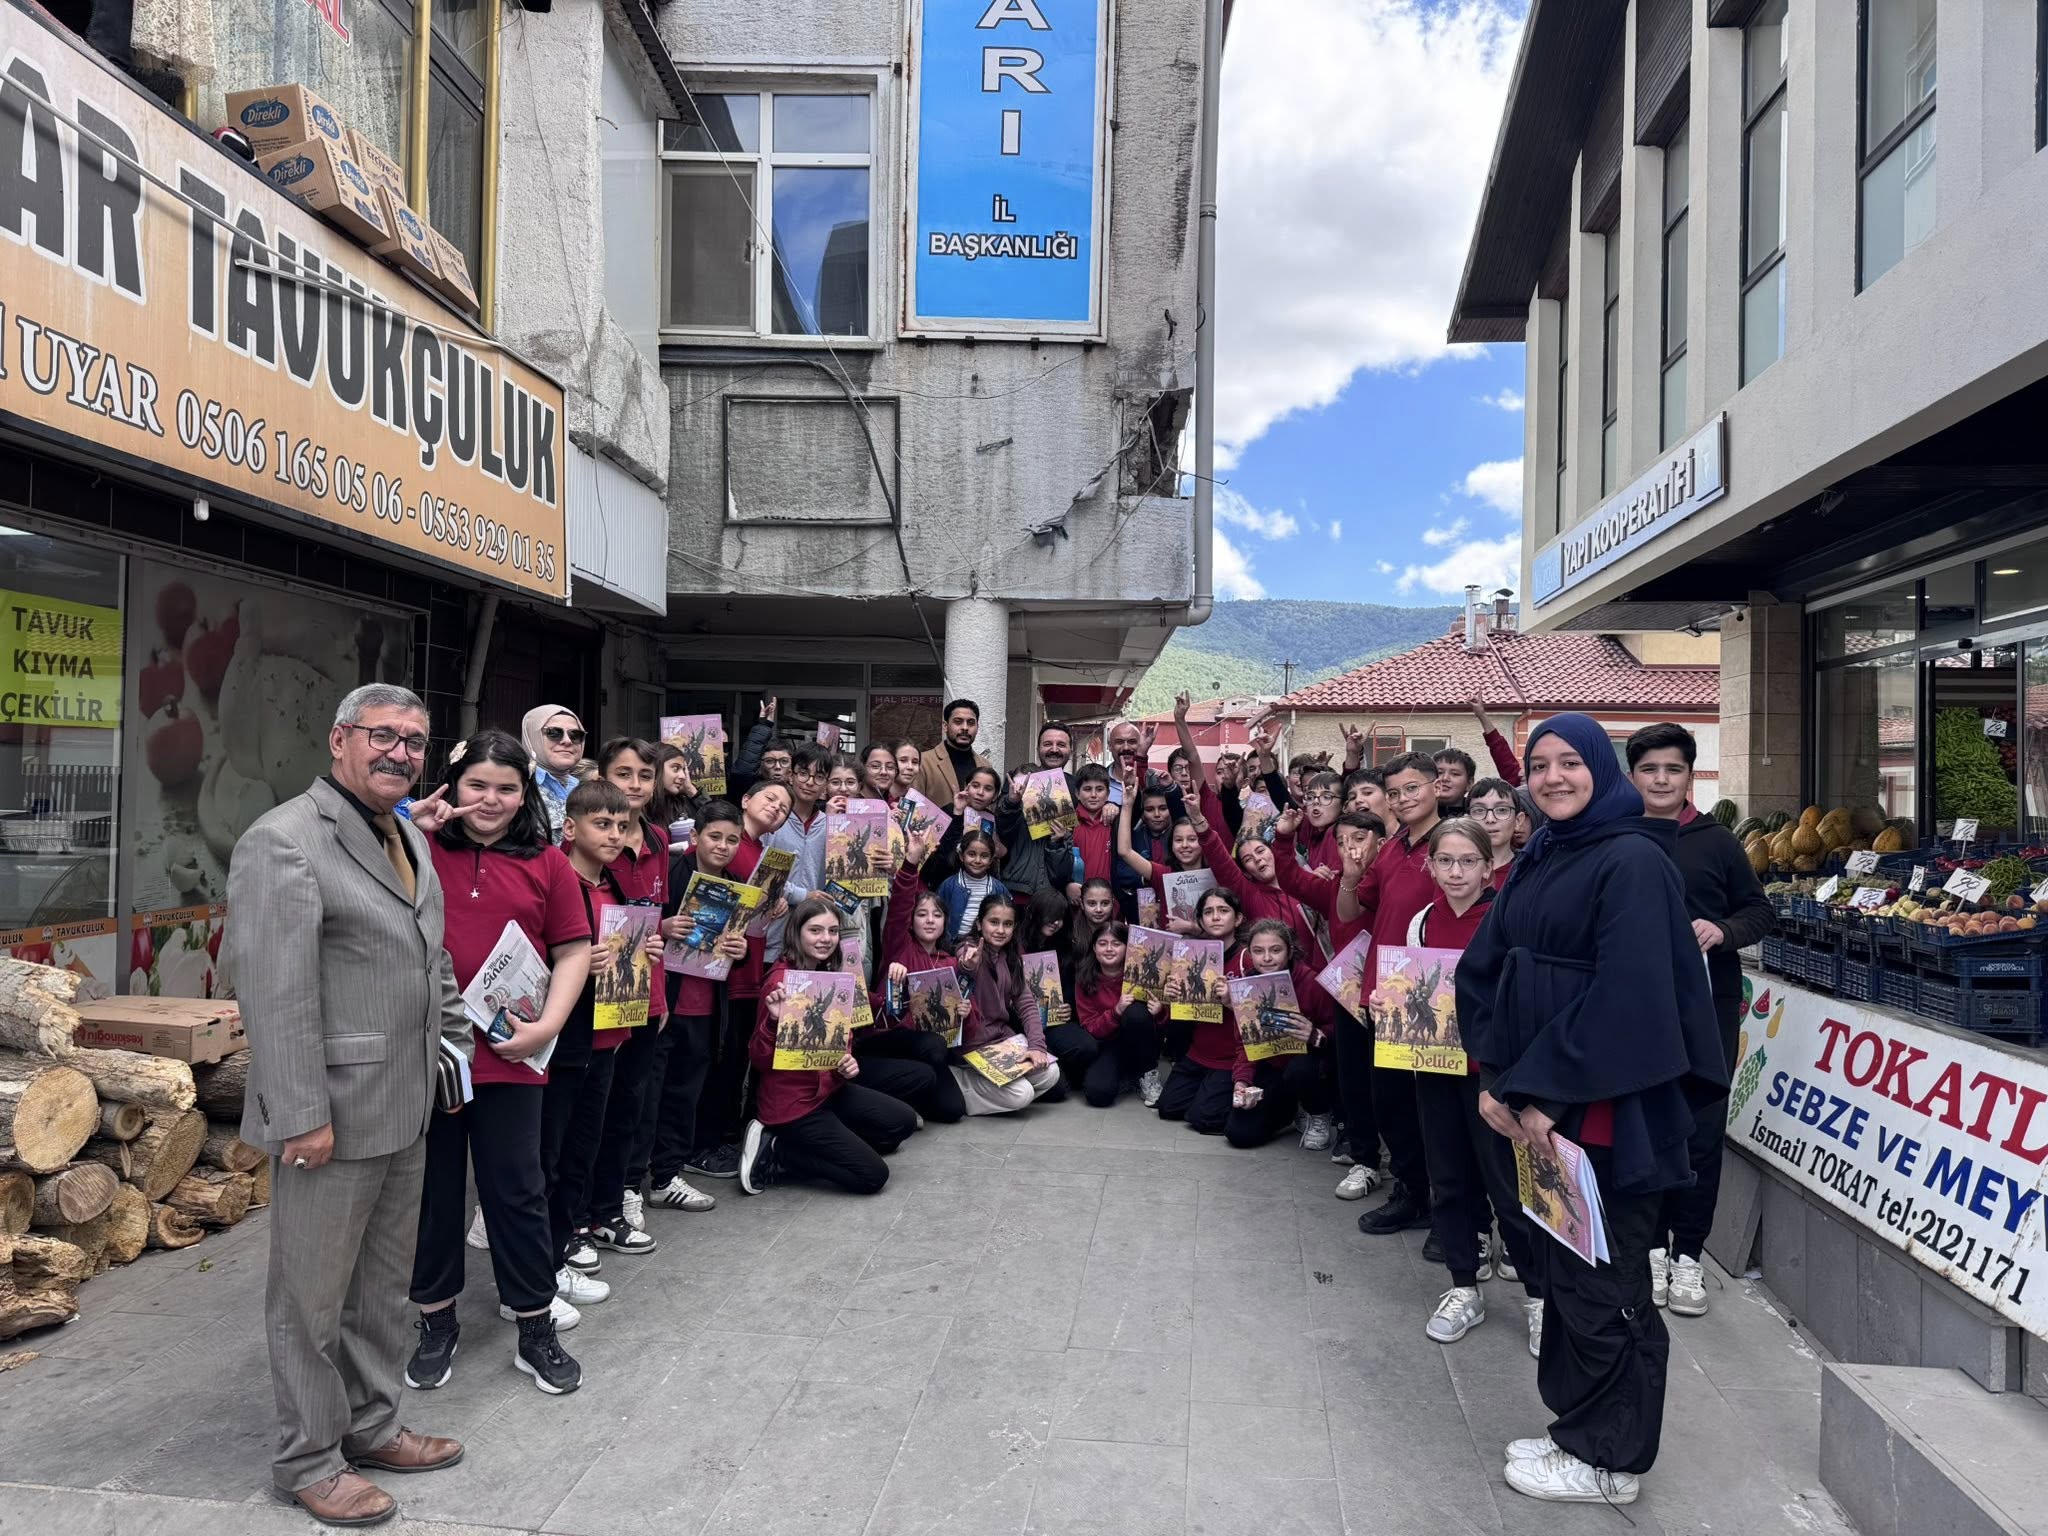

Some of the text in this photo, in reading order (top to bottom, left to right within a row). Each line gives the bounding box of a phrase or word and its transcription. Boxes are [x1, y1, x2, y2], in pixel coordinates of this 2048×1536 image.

[247, 105, 281, 122] Direkli
[273, 161, 306, 183] Direkli
[992, 194, 1016, 222] İL
[929, 231, 1078, 261] BAŞKANLIĞI
[177, 162, 557, 508] TAVUKÇULUK
[16, 315, 165, 437] UYAR
[177, 389, 266, 474] 0506
[275, 431, 328, 498] 165
[333, 455, 367, 513] 05
[372, 471, 403, 524] 06
[420, 491, 471, 550] 0553
[474, 514, 508, 565] 929
[512, 530, 532, 574] 01
[536, 540, 556, 581] 35
[1564, 532, 1593, 576] YAPI
[1591, 448, 1695, 559] KOOPERATİFİ
[11, 606, 94, 640] TAVUK
[13, 648, 95, 680] KIYMA
[1, 689, 103, 722] ÇEKİLİR
[483, 953, 513, 990] Sinan
[617, 1006, 646, 1026] Deliler
[1193, 1006, 1221, 1020] Deliler
[1411, 1050, 1463, 1071] Deliler
[1749, 1110, 1806, 1168] İsmail
[1808, 1144, 1878, 1209] TOKAT
[1766, 1071, 2048, 1252] SEBZE VE MEY
